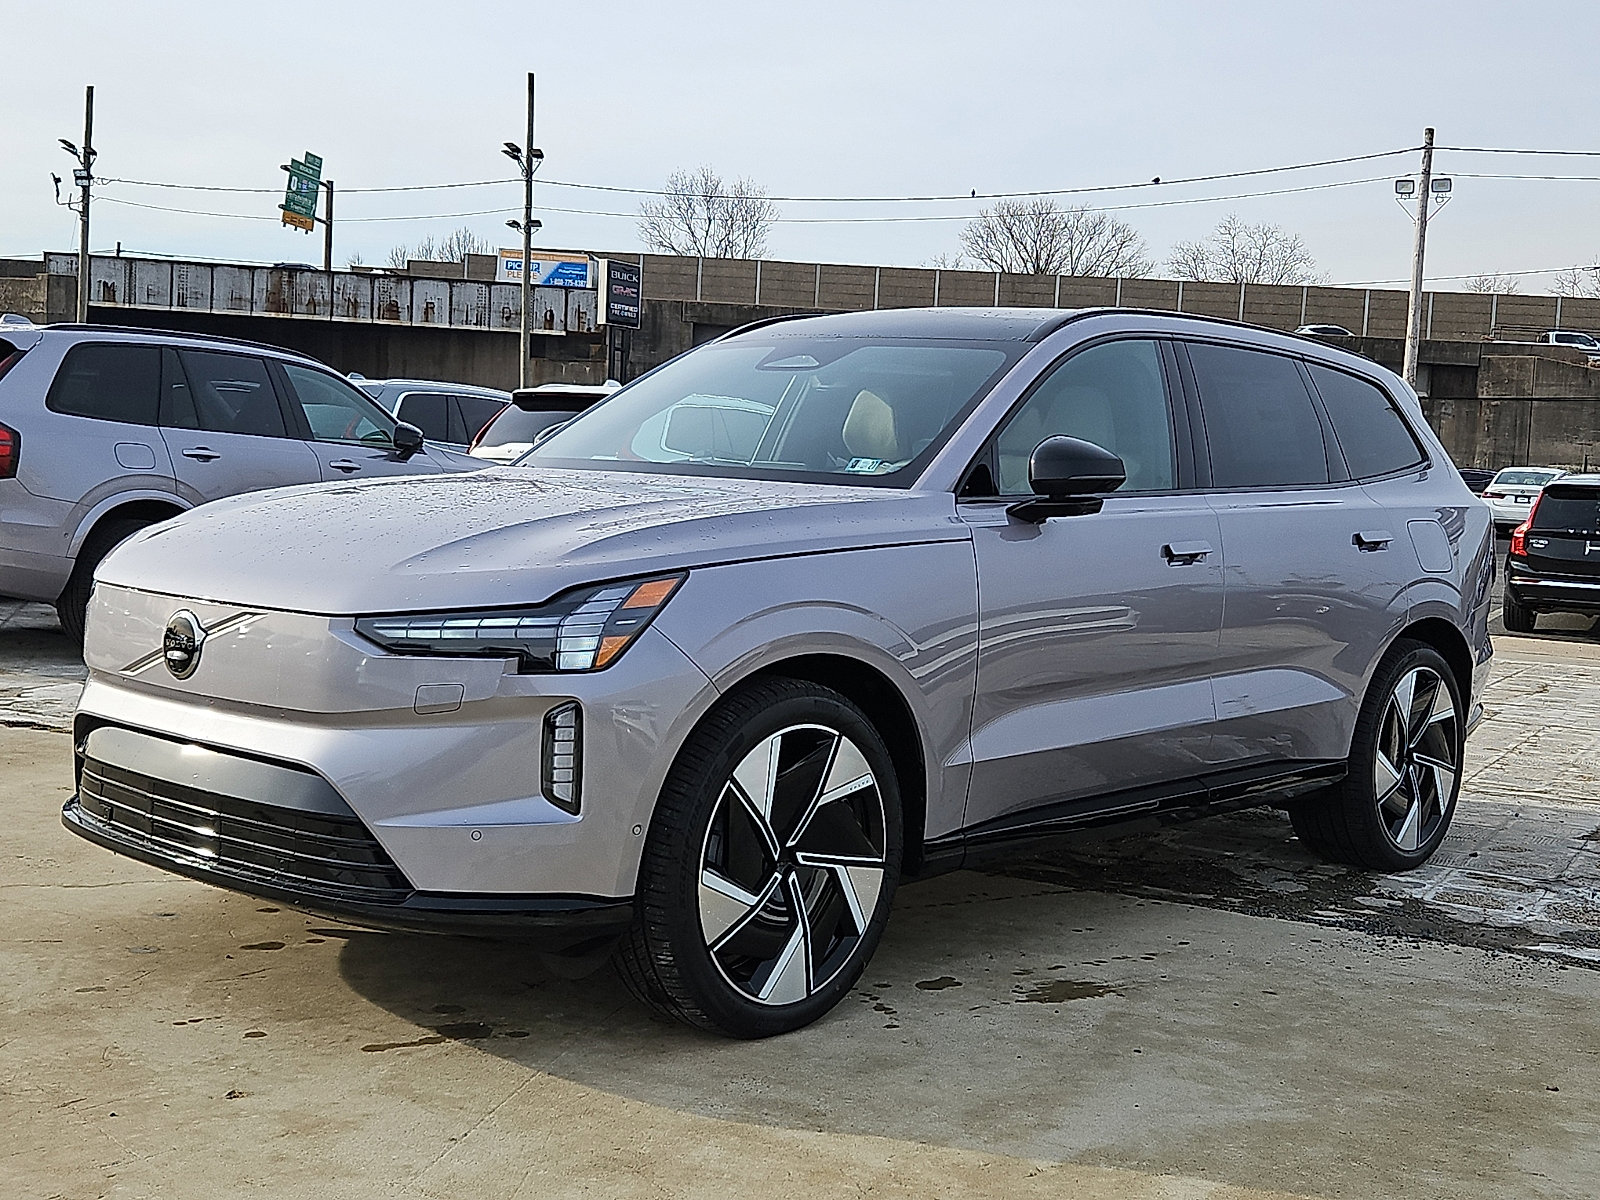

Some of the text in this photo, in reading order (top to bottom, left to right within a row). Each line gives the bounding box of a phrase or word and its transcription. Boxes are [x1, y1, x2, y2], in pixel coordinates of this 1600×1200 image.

[611, 270, 639, 283] BUICK
[612, 284, 638, 298] GMC
[610, 302, 638, 313] CERTIFIED
